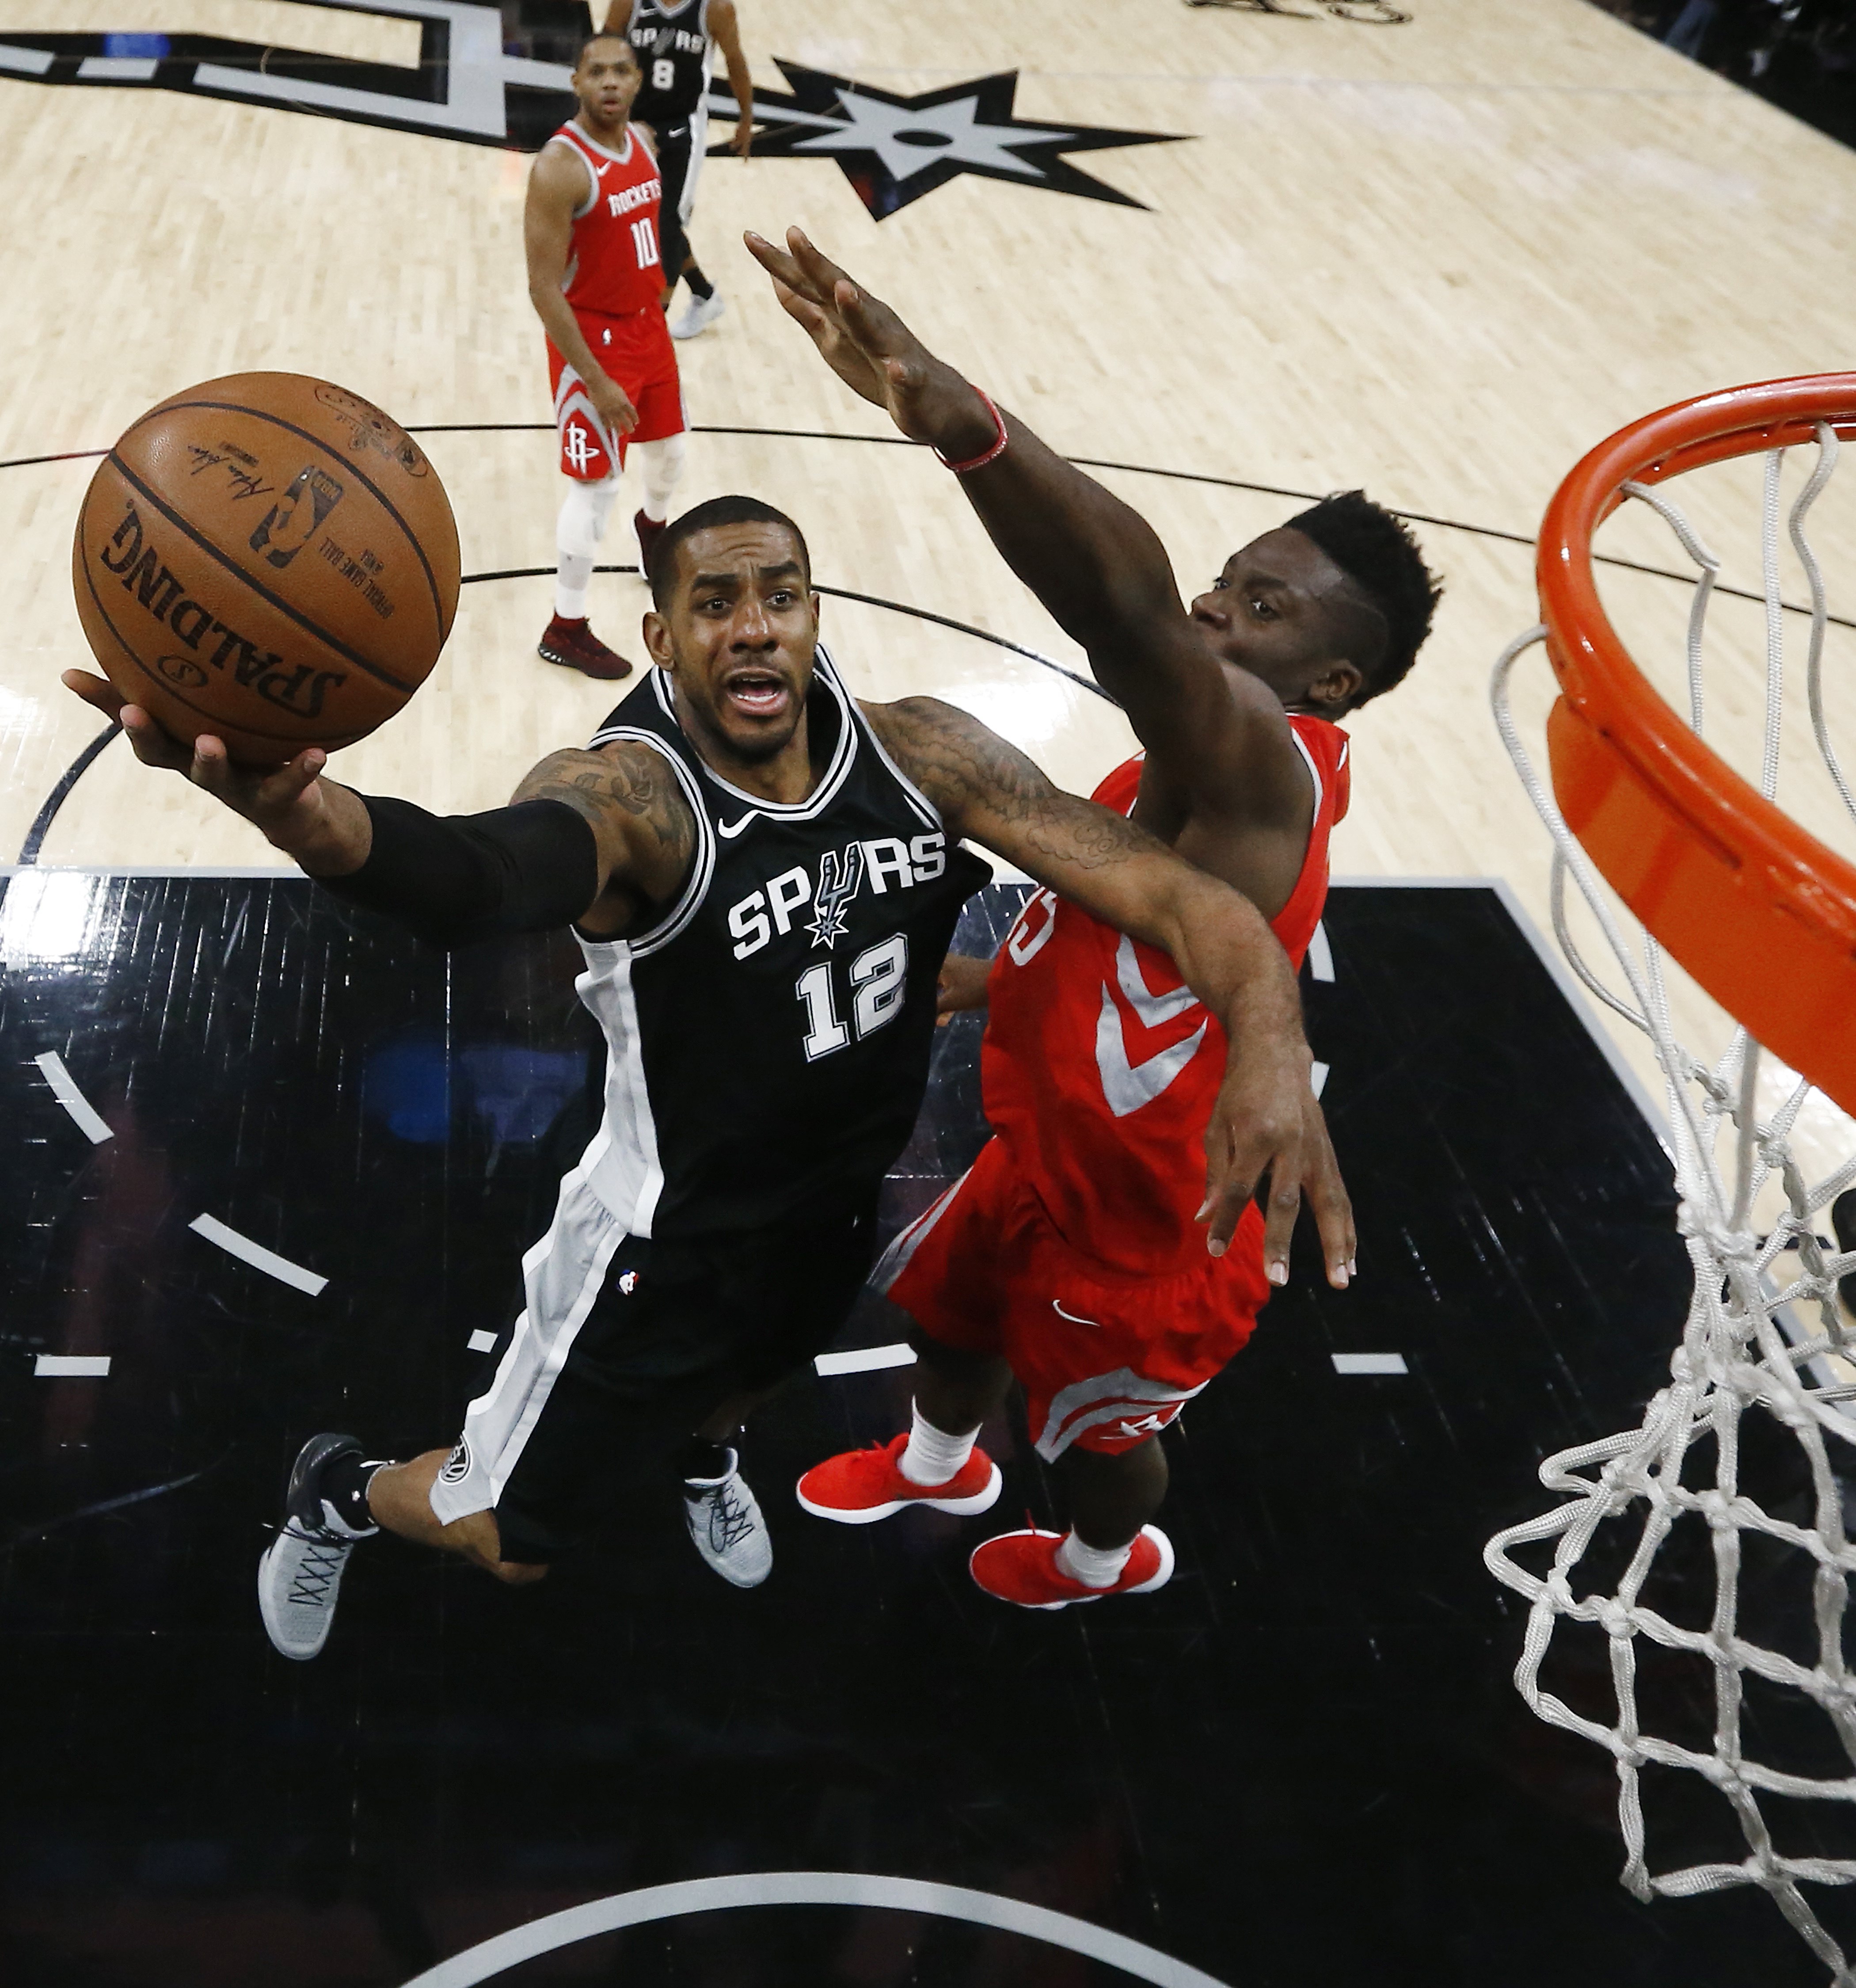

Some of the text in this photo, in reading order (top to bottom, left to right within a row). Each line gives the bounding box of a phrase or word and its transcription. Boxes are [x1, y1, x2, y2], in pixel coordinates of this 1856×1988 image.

[652, 58, 675, 91] 8
[630, 218, 660, 270] 10
[319, 537, 344, 566] BALL
[100, 509, 347, 719] SPALDING
[728, 832, 945, 960] SPURS
[796, 932, 909, 1062] 12
